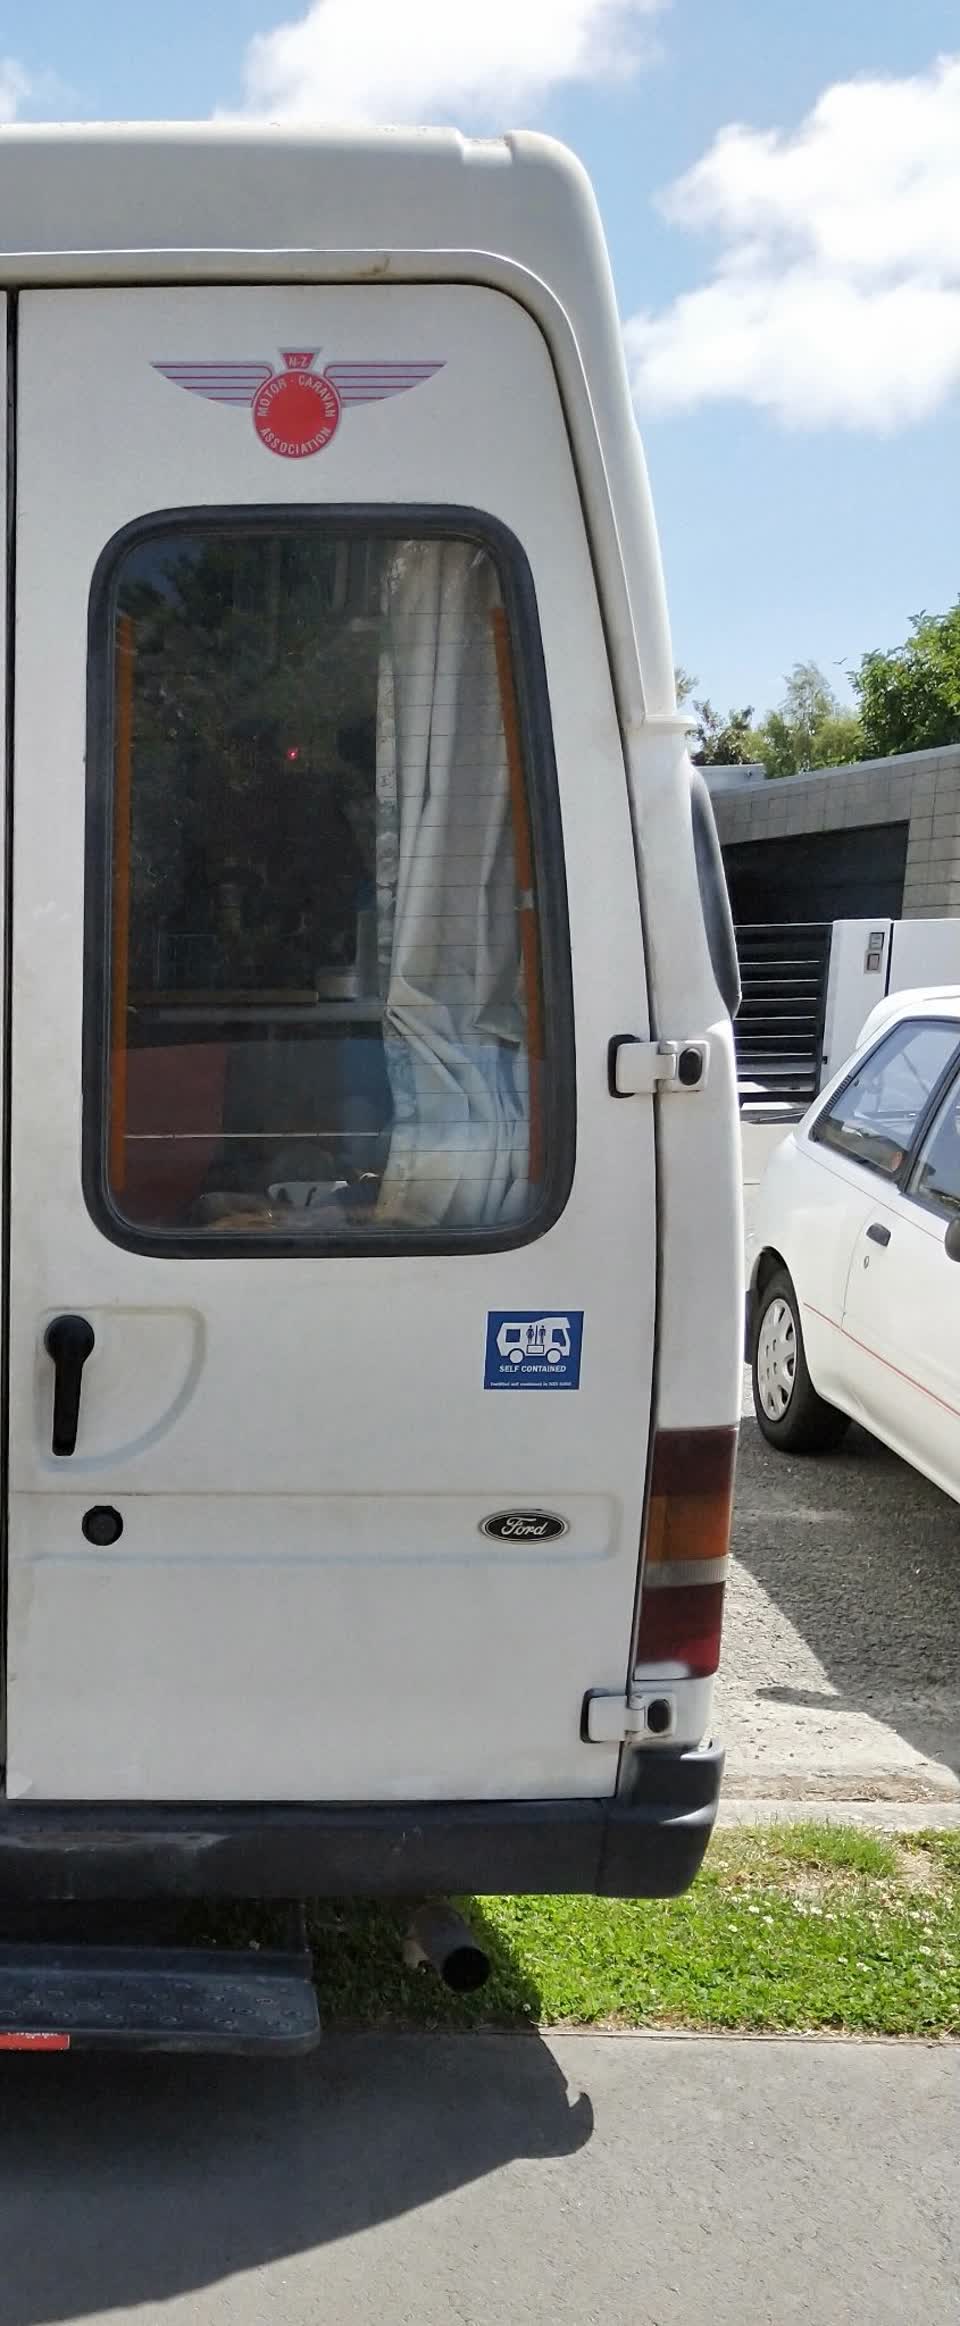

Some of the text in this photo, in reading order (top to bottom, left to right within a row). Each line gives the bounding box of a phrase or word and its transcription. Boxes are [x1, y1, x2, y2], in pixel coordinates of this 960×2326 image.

[257, 374, 336, 418] MOTOR CARAVAN
[260, 427, 331, 455] ASSOCIATION
[499, 1365, 567, 1373] SELF CONTAINED
[501, 1517, 548, 1535] Ford
